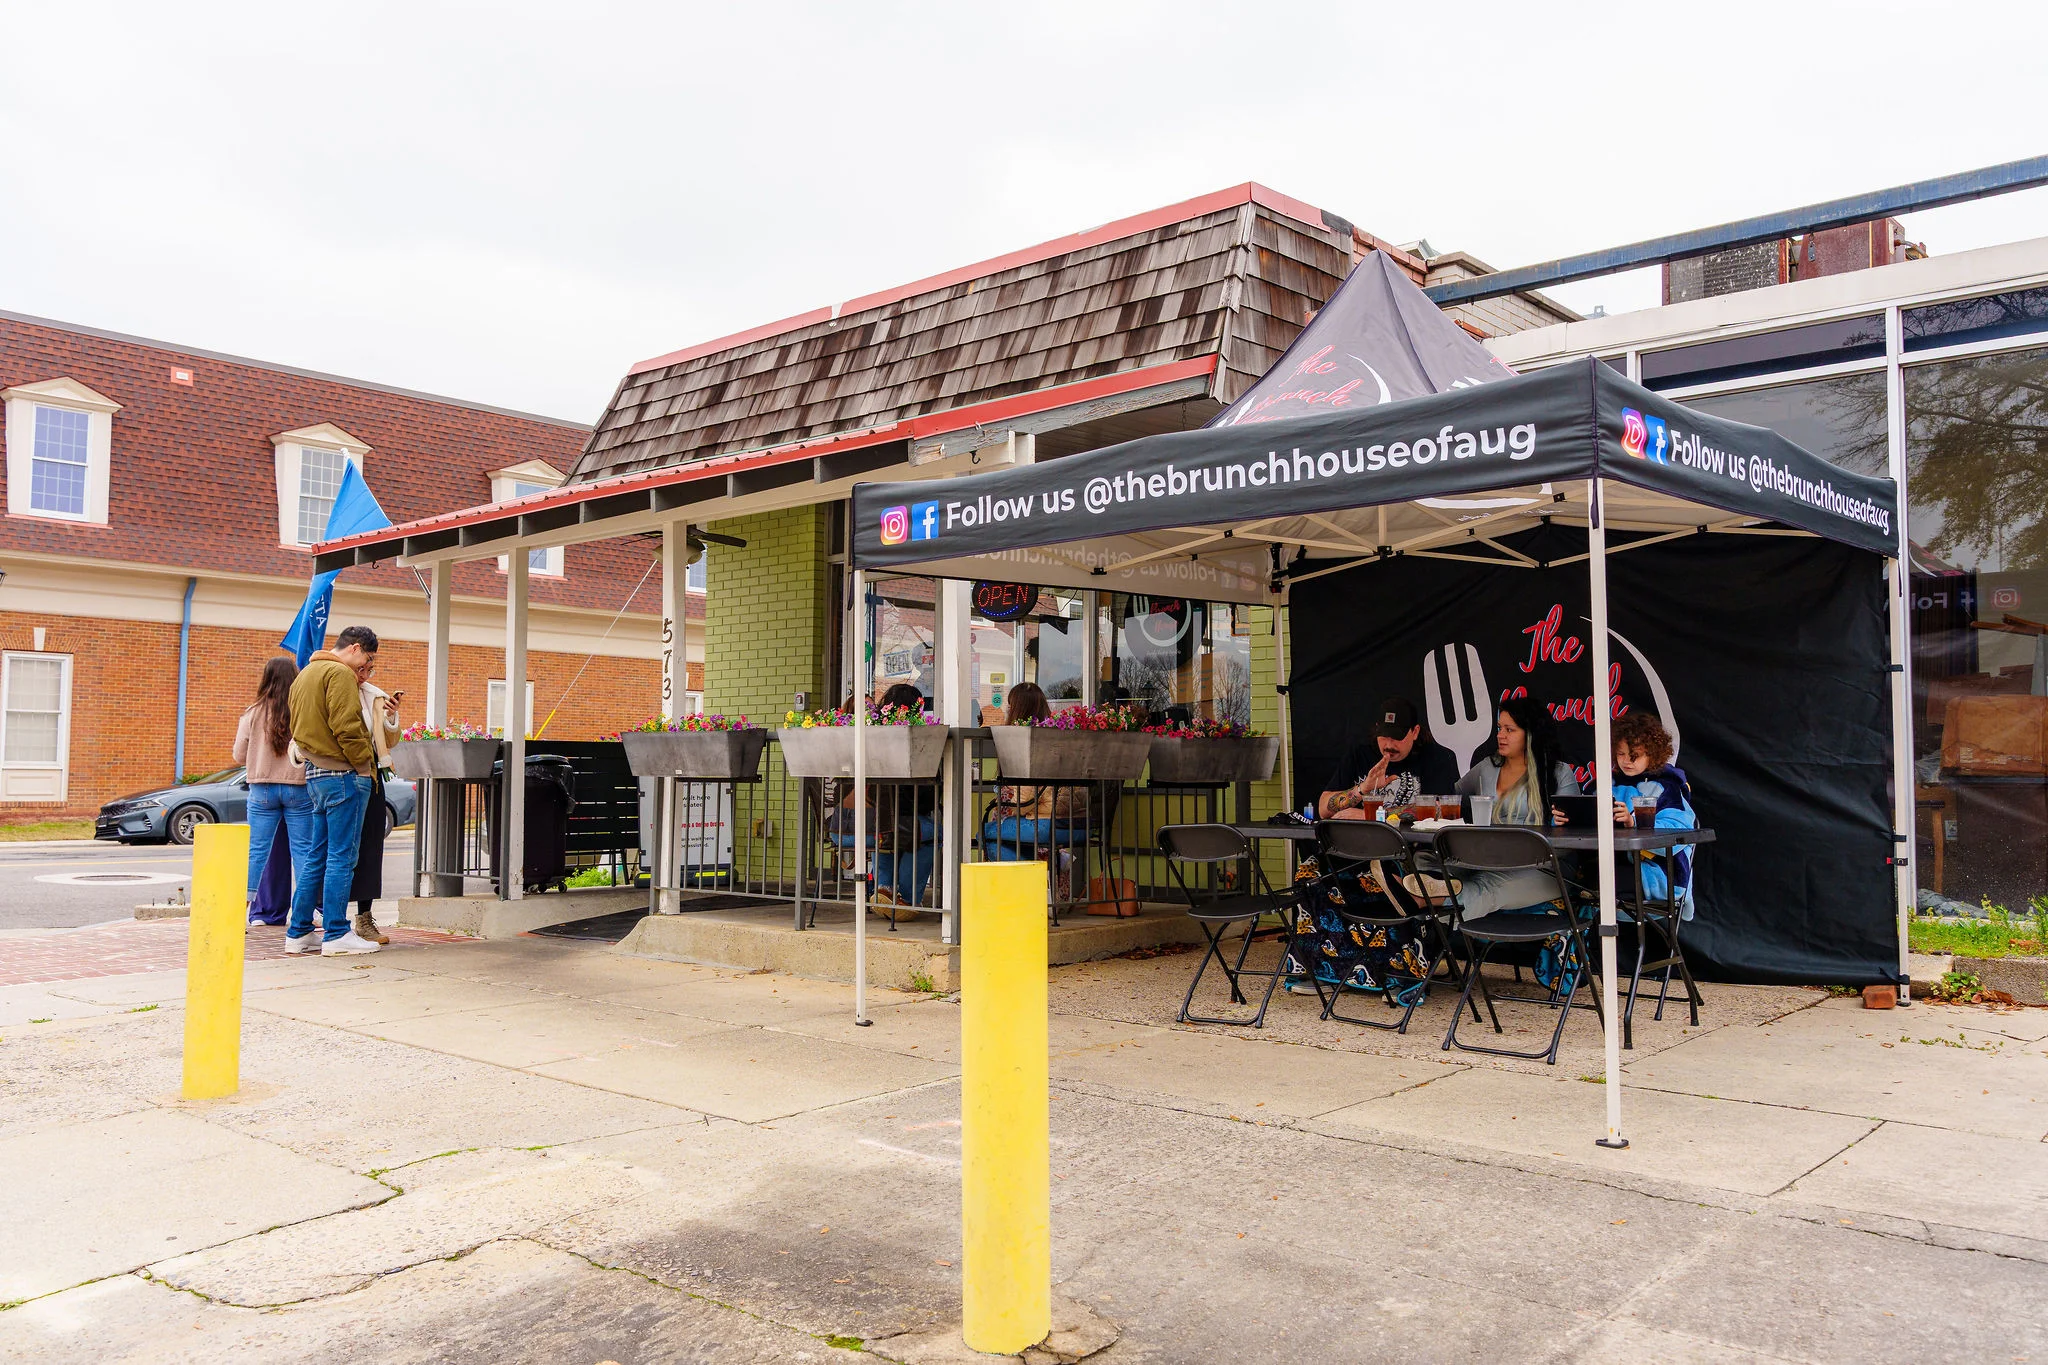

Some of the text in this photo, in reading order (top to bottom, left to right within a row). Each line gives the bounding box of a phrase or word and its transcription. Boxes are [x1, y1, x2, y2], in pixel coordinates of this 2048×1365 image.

[946, 422, 1536, 529] Follow us @thebrunchhouseofaug
[1670, 429, 1890, 536] Follow us @thebrunchhouseofaug
[977, 584, 1029, 608] OPEN
[1518, 603, 1585, 674] The
